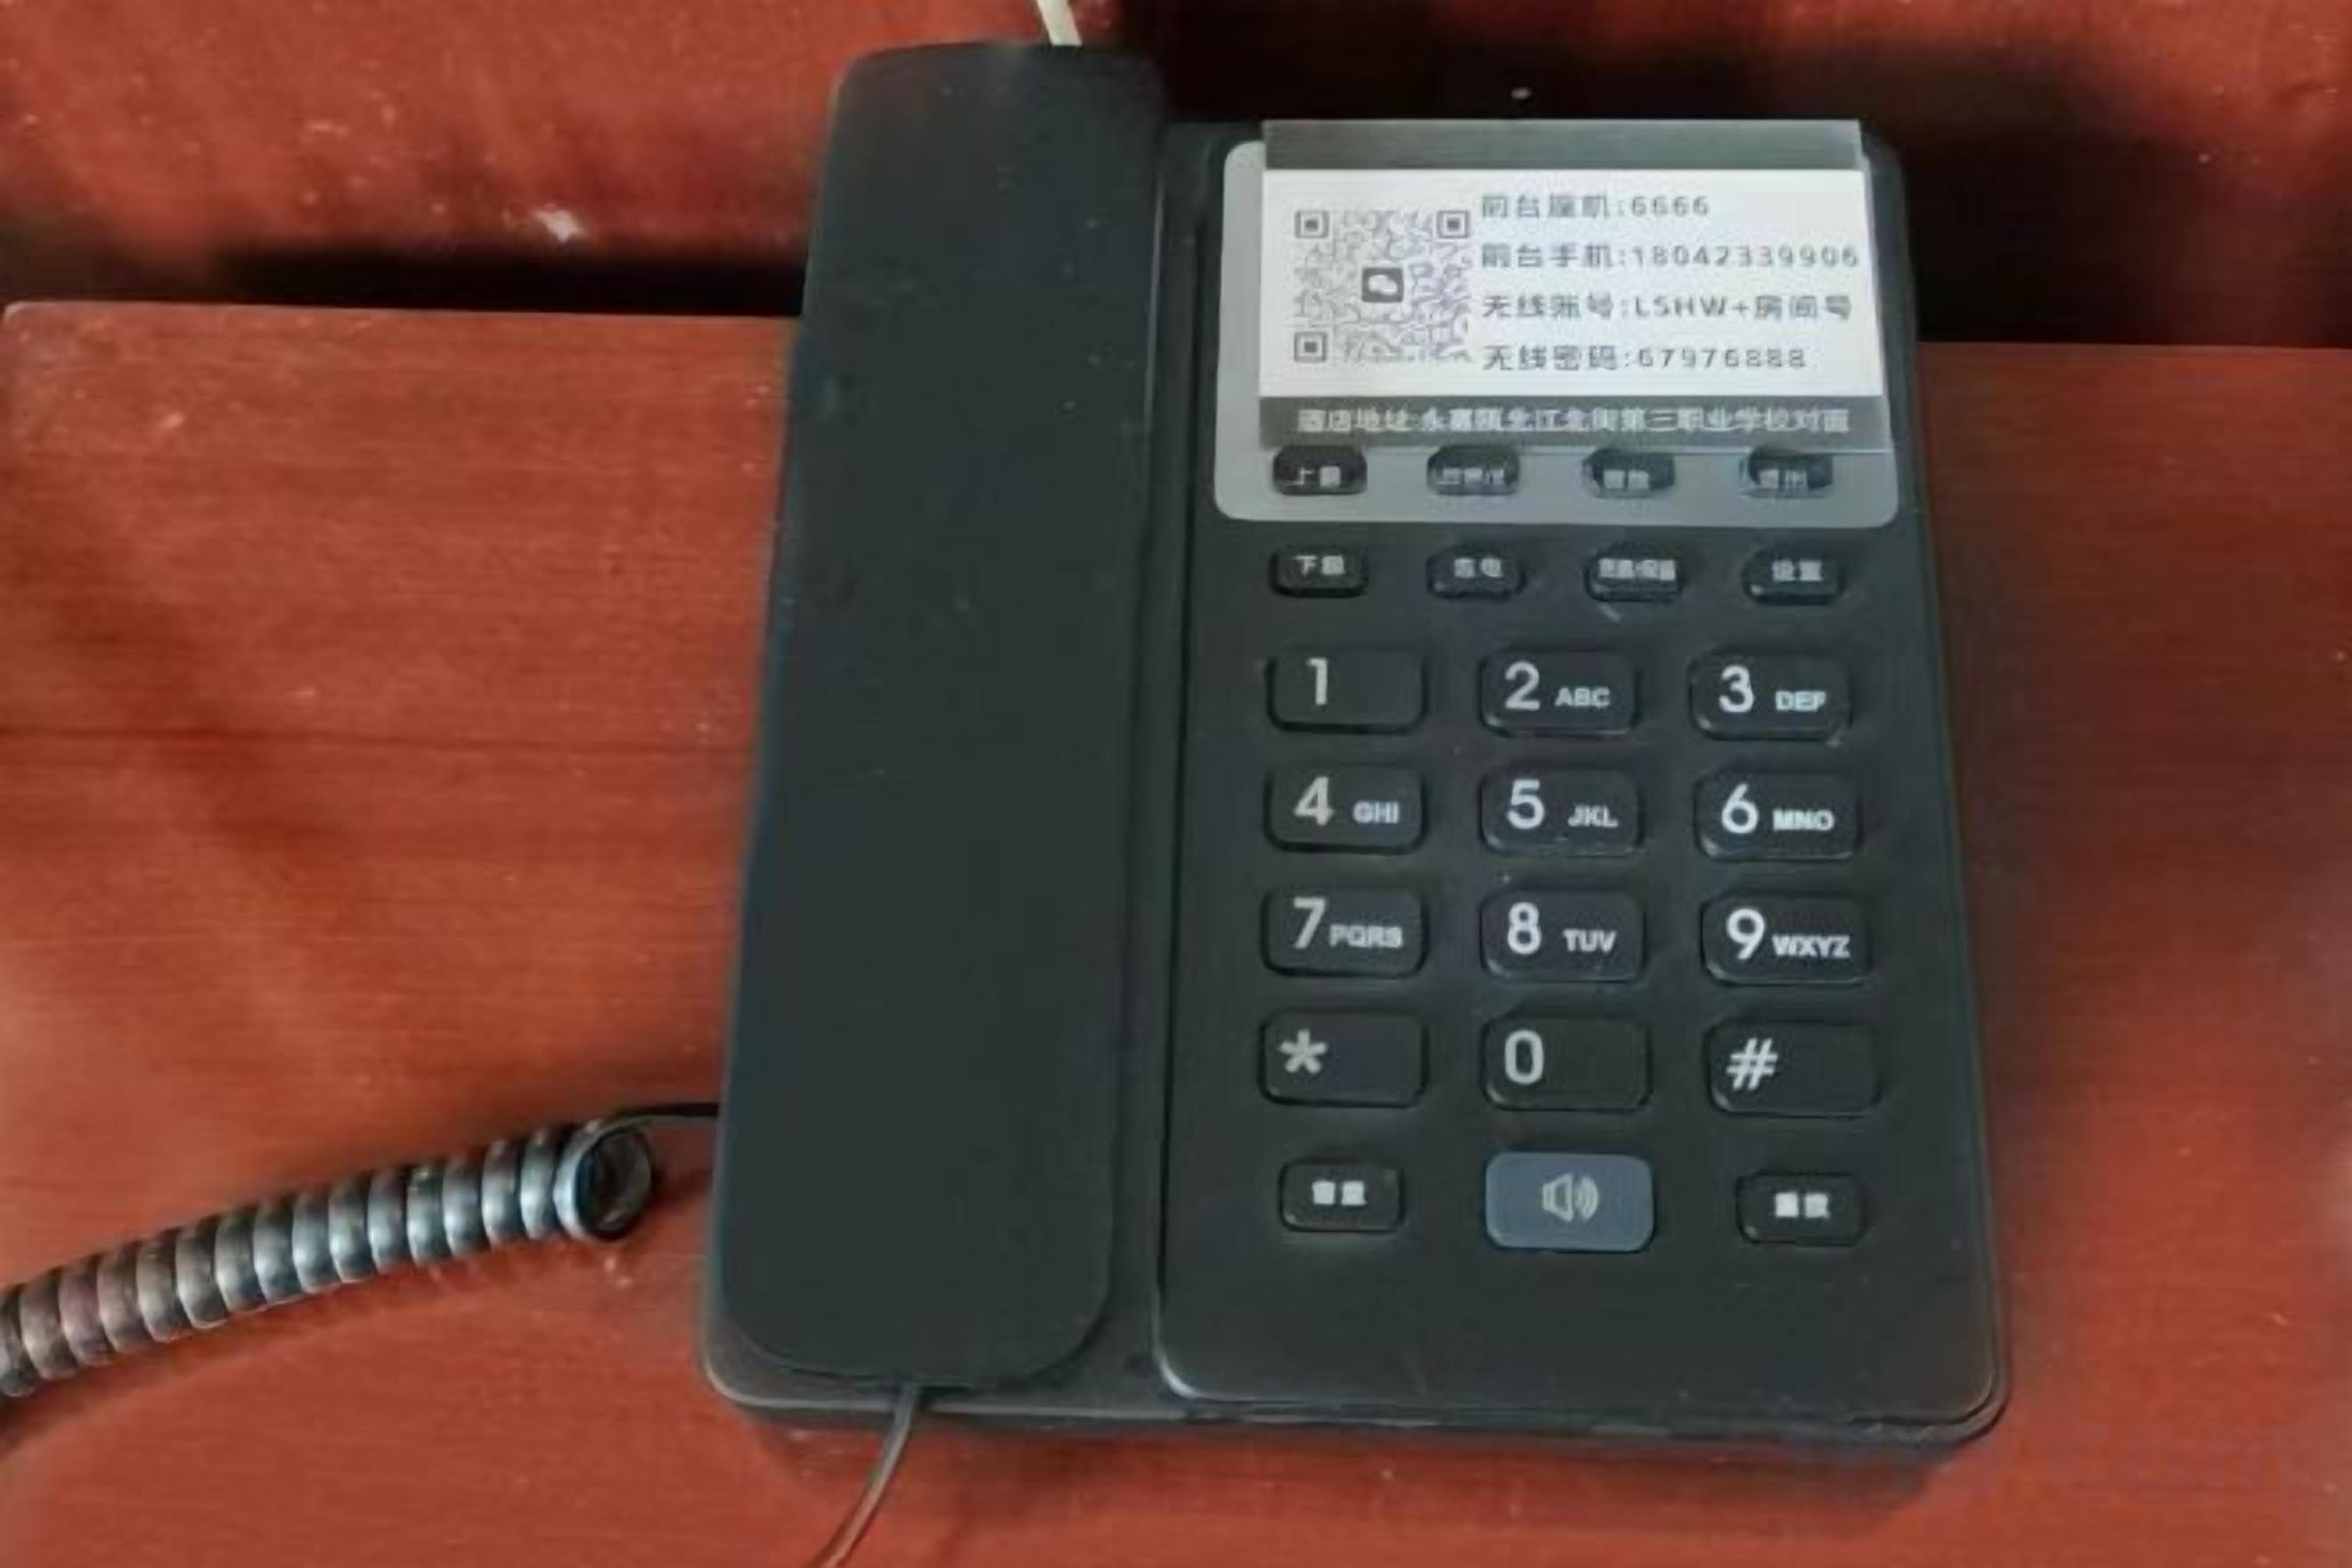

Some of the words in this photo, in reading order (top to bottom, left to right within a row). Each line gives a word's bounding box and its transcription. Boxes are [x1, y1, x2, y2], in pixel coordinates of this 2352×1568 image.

[1309, 657, 1328, 706] 1
[1505, 661, 1540, 711] 2
[1555, 687, 1610, 708] ABC
[1719, 665, 1755, 714] 3
[1775, 690, 1826, 712] DEF
[1294, 776, 1334, 826] 4
[1353, 801, 1400, 824] GHI
[1507, 779, 1545, 829] 5
[1567, 805, 1618, 828] JKL
[1721, 783, 1760, 834] 6
[1772, 809, 1834, 831] MNO
[1294, 896, 1327, 949] 7
[1330, 924, 1403, 948] PQRS
[1507, 902, 1542, 955] 8
[1564, 928, 1616, 952] TUV
[1727, 908, 1766, 960] 9
[1771, 935, 1850, 958] WXYZ
[1504, 1029, 1545, 1084] 0
